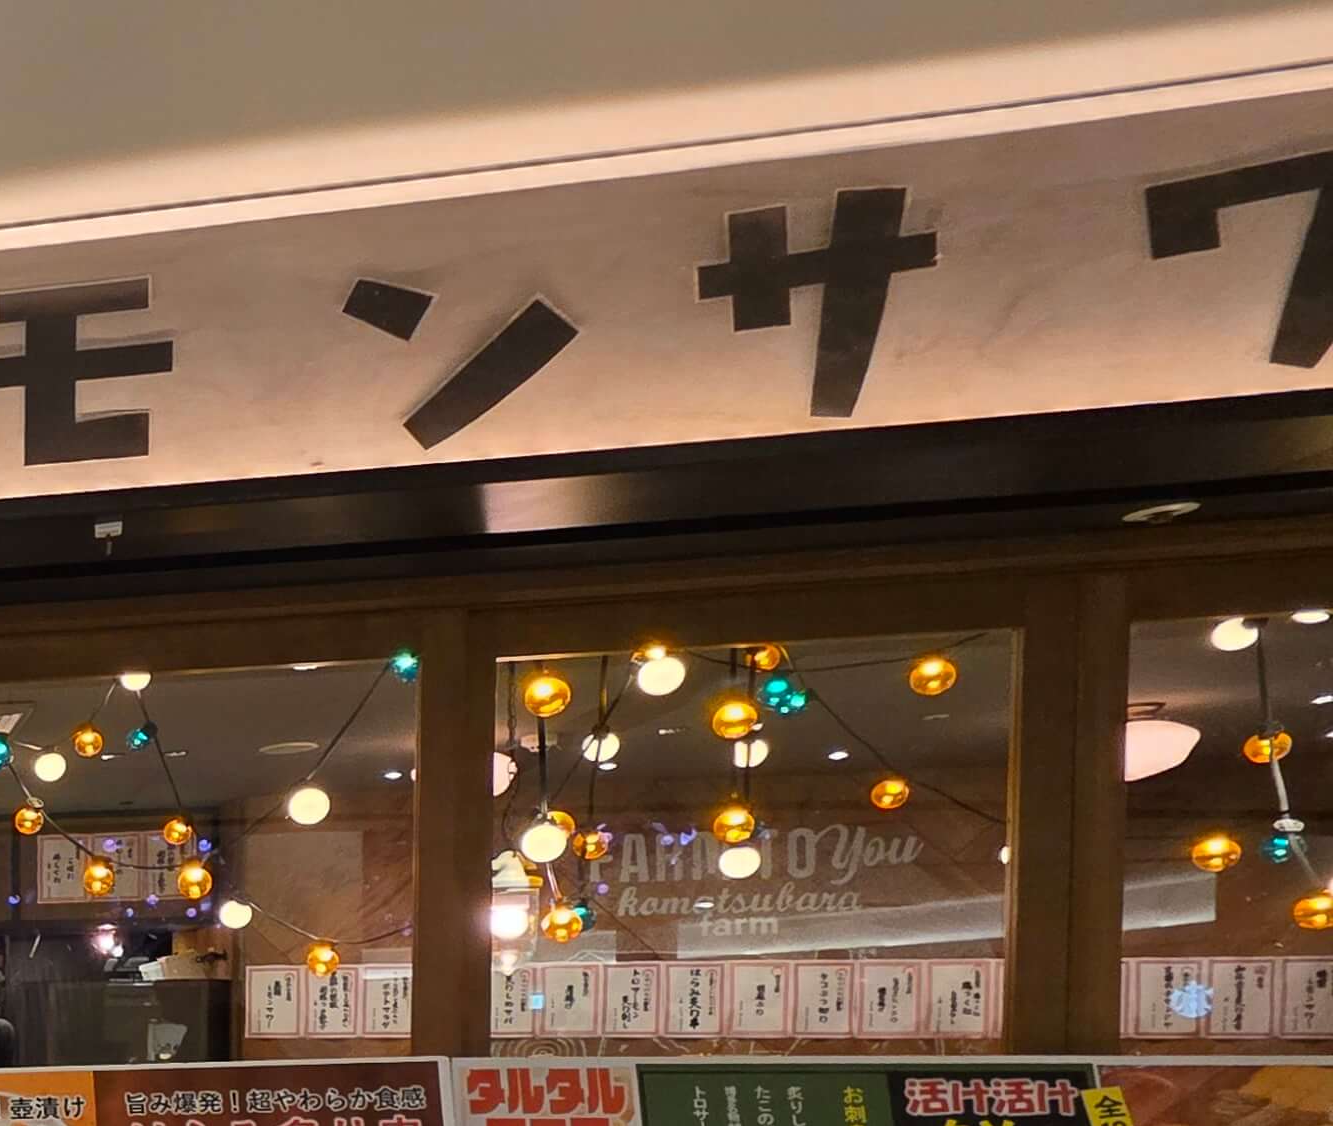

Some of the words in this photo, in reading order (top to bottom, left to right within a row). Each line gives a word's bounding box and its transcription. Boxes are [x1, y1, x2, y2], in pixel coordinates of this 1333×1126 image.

[699, 913, 779, 937] farm
[466, 1067, 629, 1115] タルタル
[904, 1078, 1079, 1118] 活け活け
